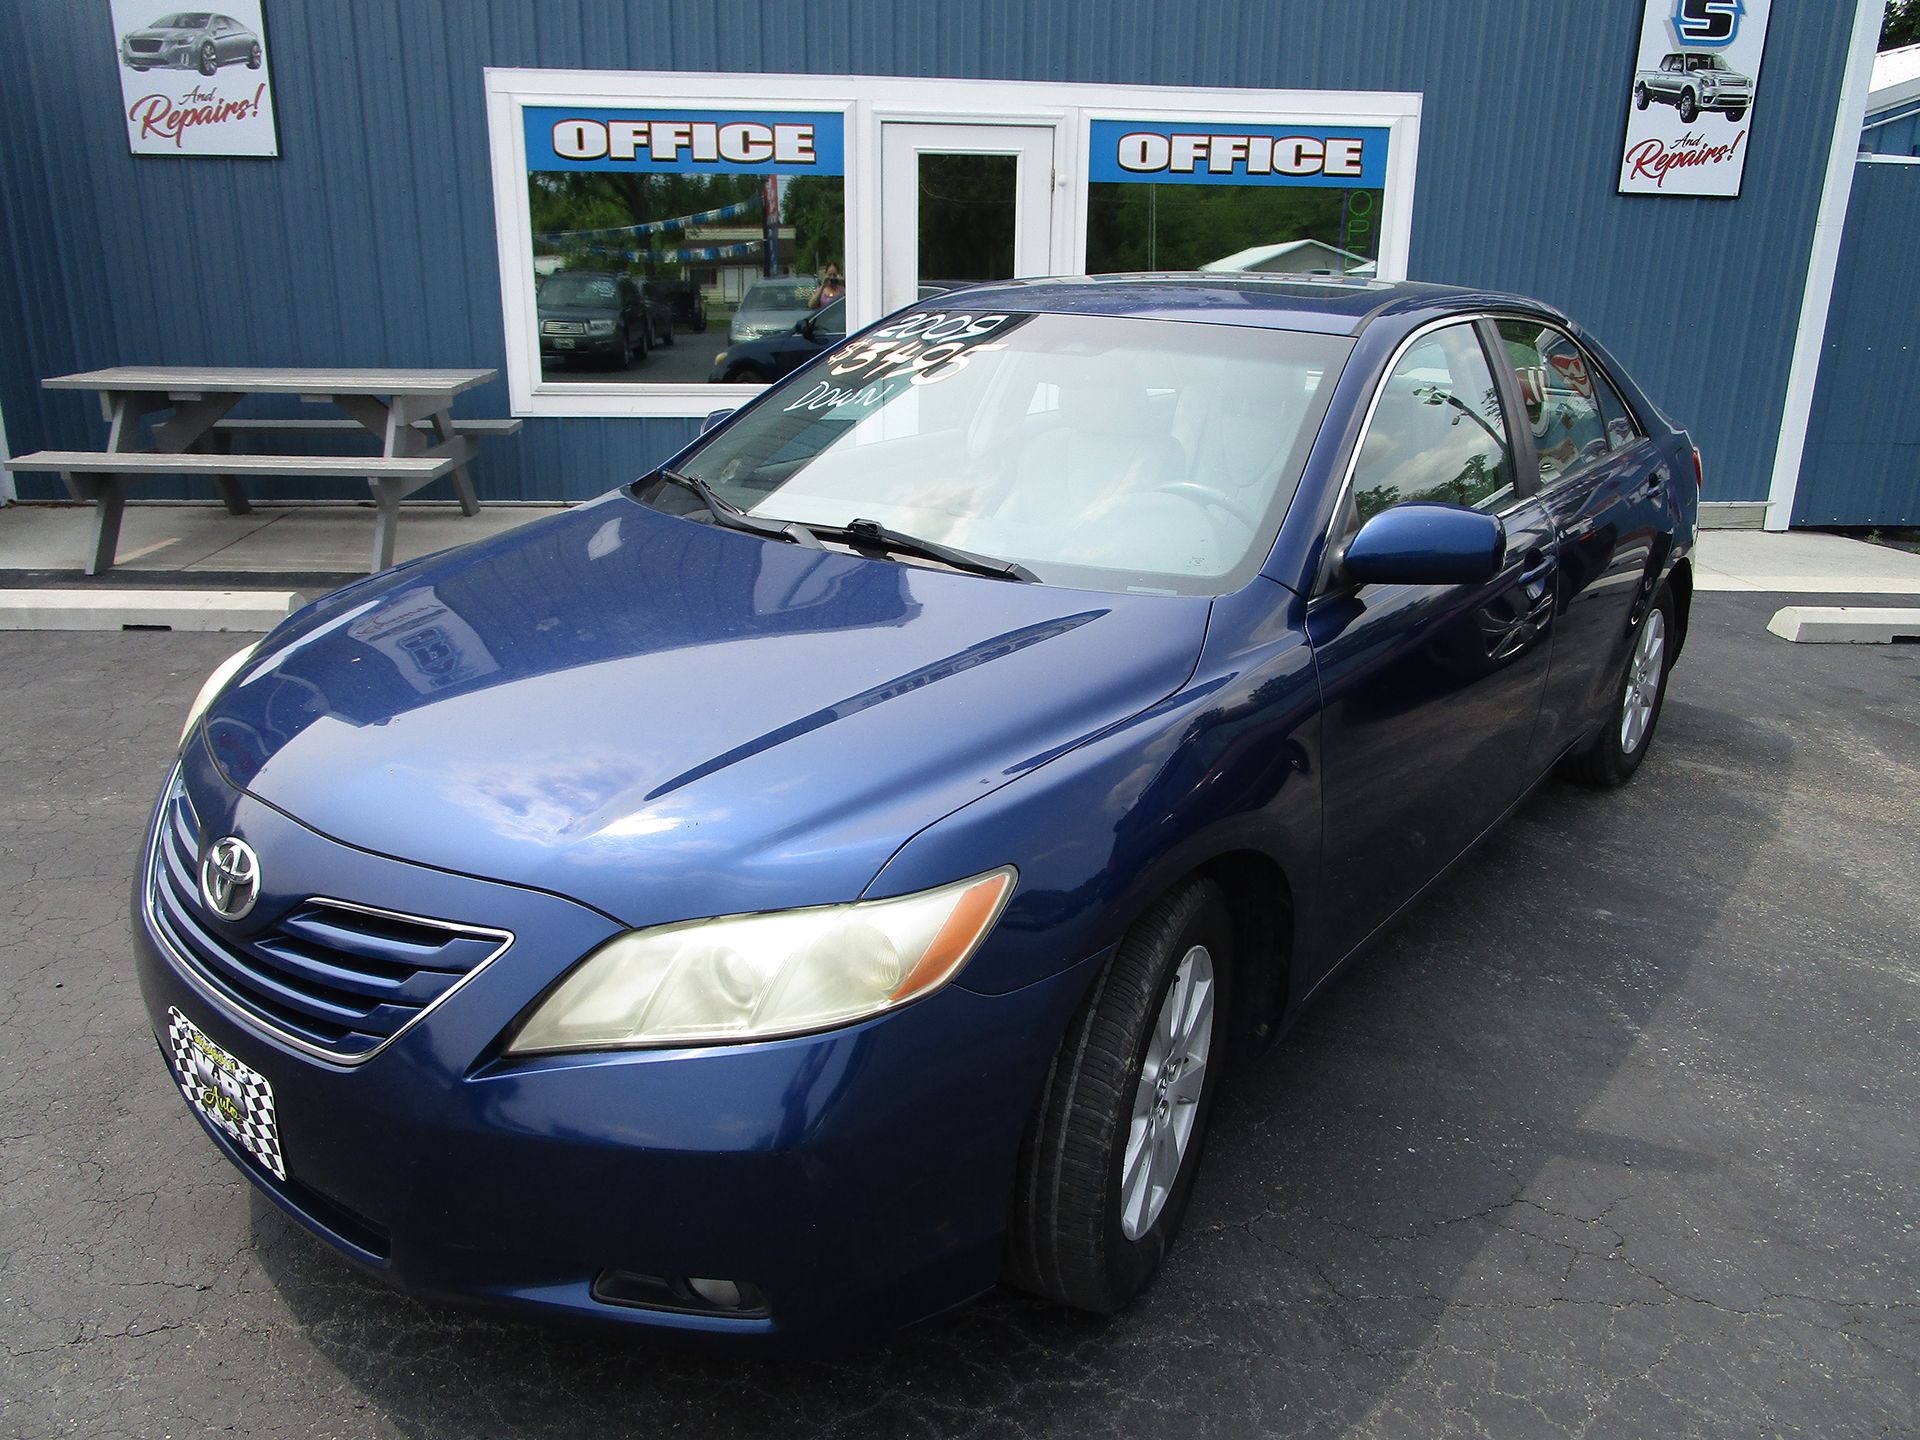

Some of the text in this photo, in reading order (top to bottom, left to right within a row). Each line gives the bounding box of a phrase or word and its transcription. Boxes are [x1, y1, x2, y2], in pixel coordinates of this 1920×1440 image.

[178, 85, 217, 105] And
[129, 83, 266, 148] Repairs!
[552, 118, 816, 164] OFFICE
[1117, 131, 1364, 177] OFFICE
[1670, 131, 1705, 149] And
[1625, 130, 1745, 188] Repairs!
[873, 313, 1010, 345] 2009
[784, 381, 894, 412] DOWN
[203, 1085, 241, 1121] Auto
